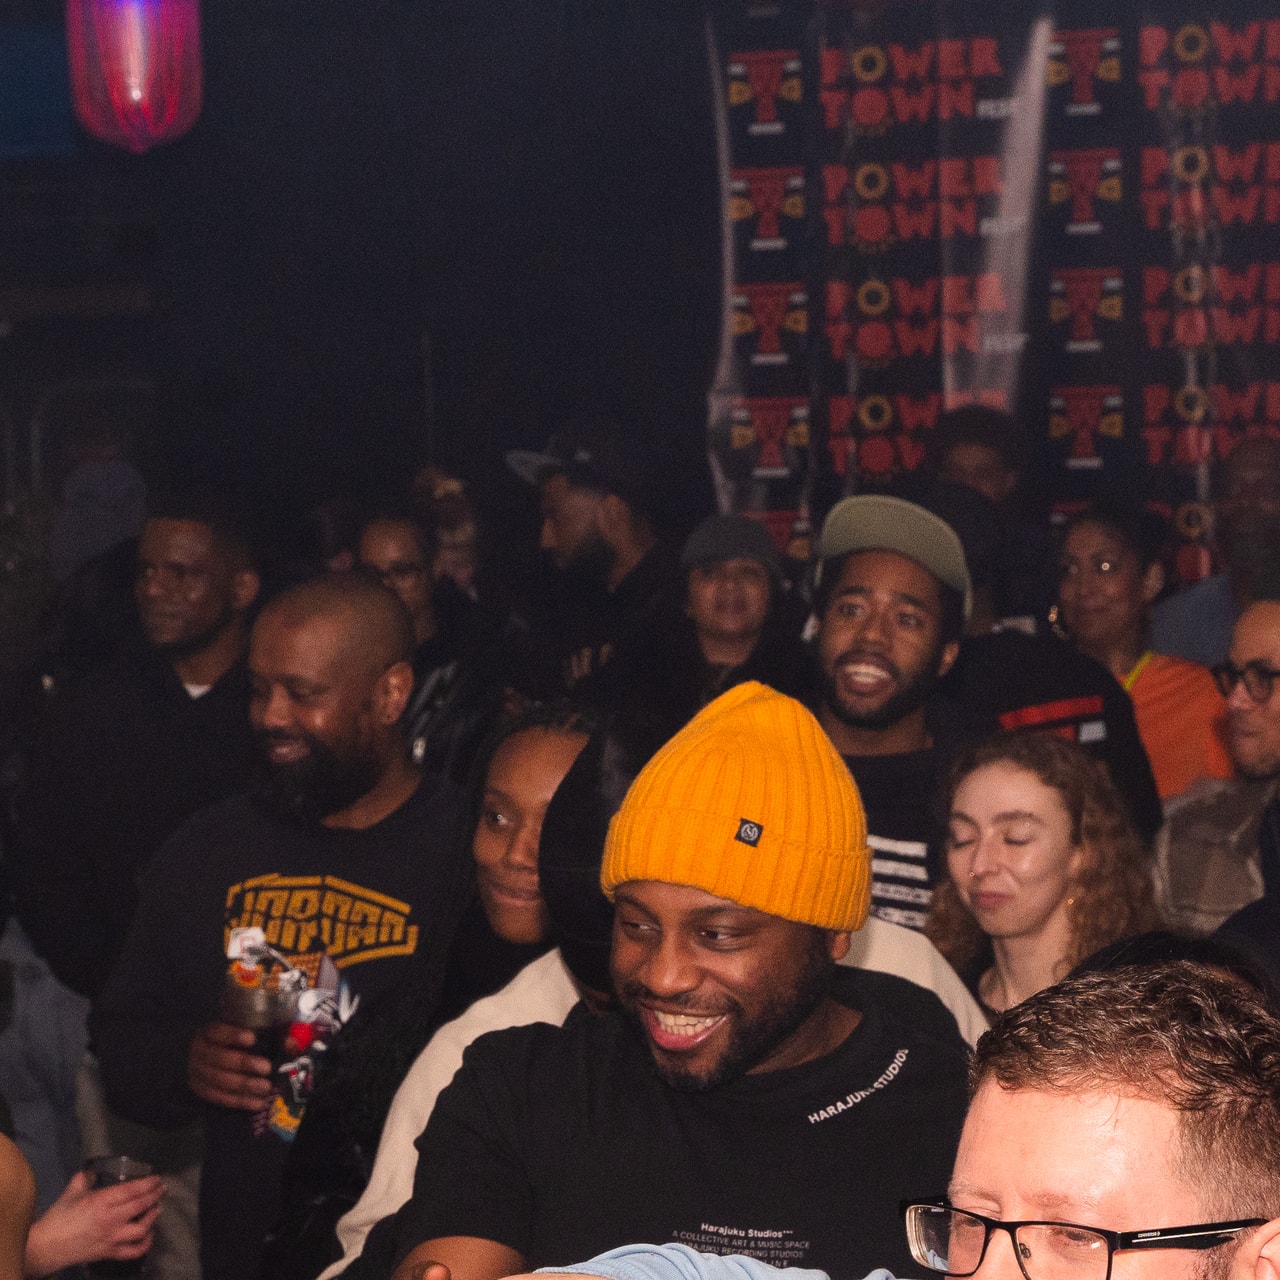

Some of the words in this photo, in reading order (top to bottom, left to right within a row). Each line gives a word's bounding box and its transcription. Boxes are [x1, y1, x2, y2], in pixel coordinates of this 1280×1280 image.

[821, 38, 1002, 85] POWER
[819, 81, 975, 129] TOWN
[822, 155, 1004, 200] POWER
[823, 200, 976, 245] TOWN
[825, 272, 1008, 318] POWER
[825, 316, 979, 360] TOWN
[680, 1231, 730, 1245] COLLECTIVE
[731, 1239, 747, 1247] ART
[757, 1240, 782, 1249] MUSIC
[784, 1241, 810, 1249] SPACE
[701, 1222, 745, 1237] Harajuku
[770, 1250, 804, 1258] STUDIOS
